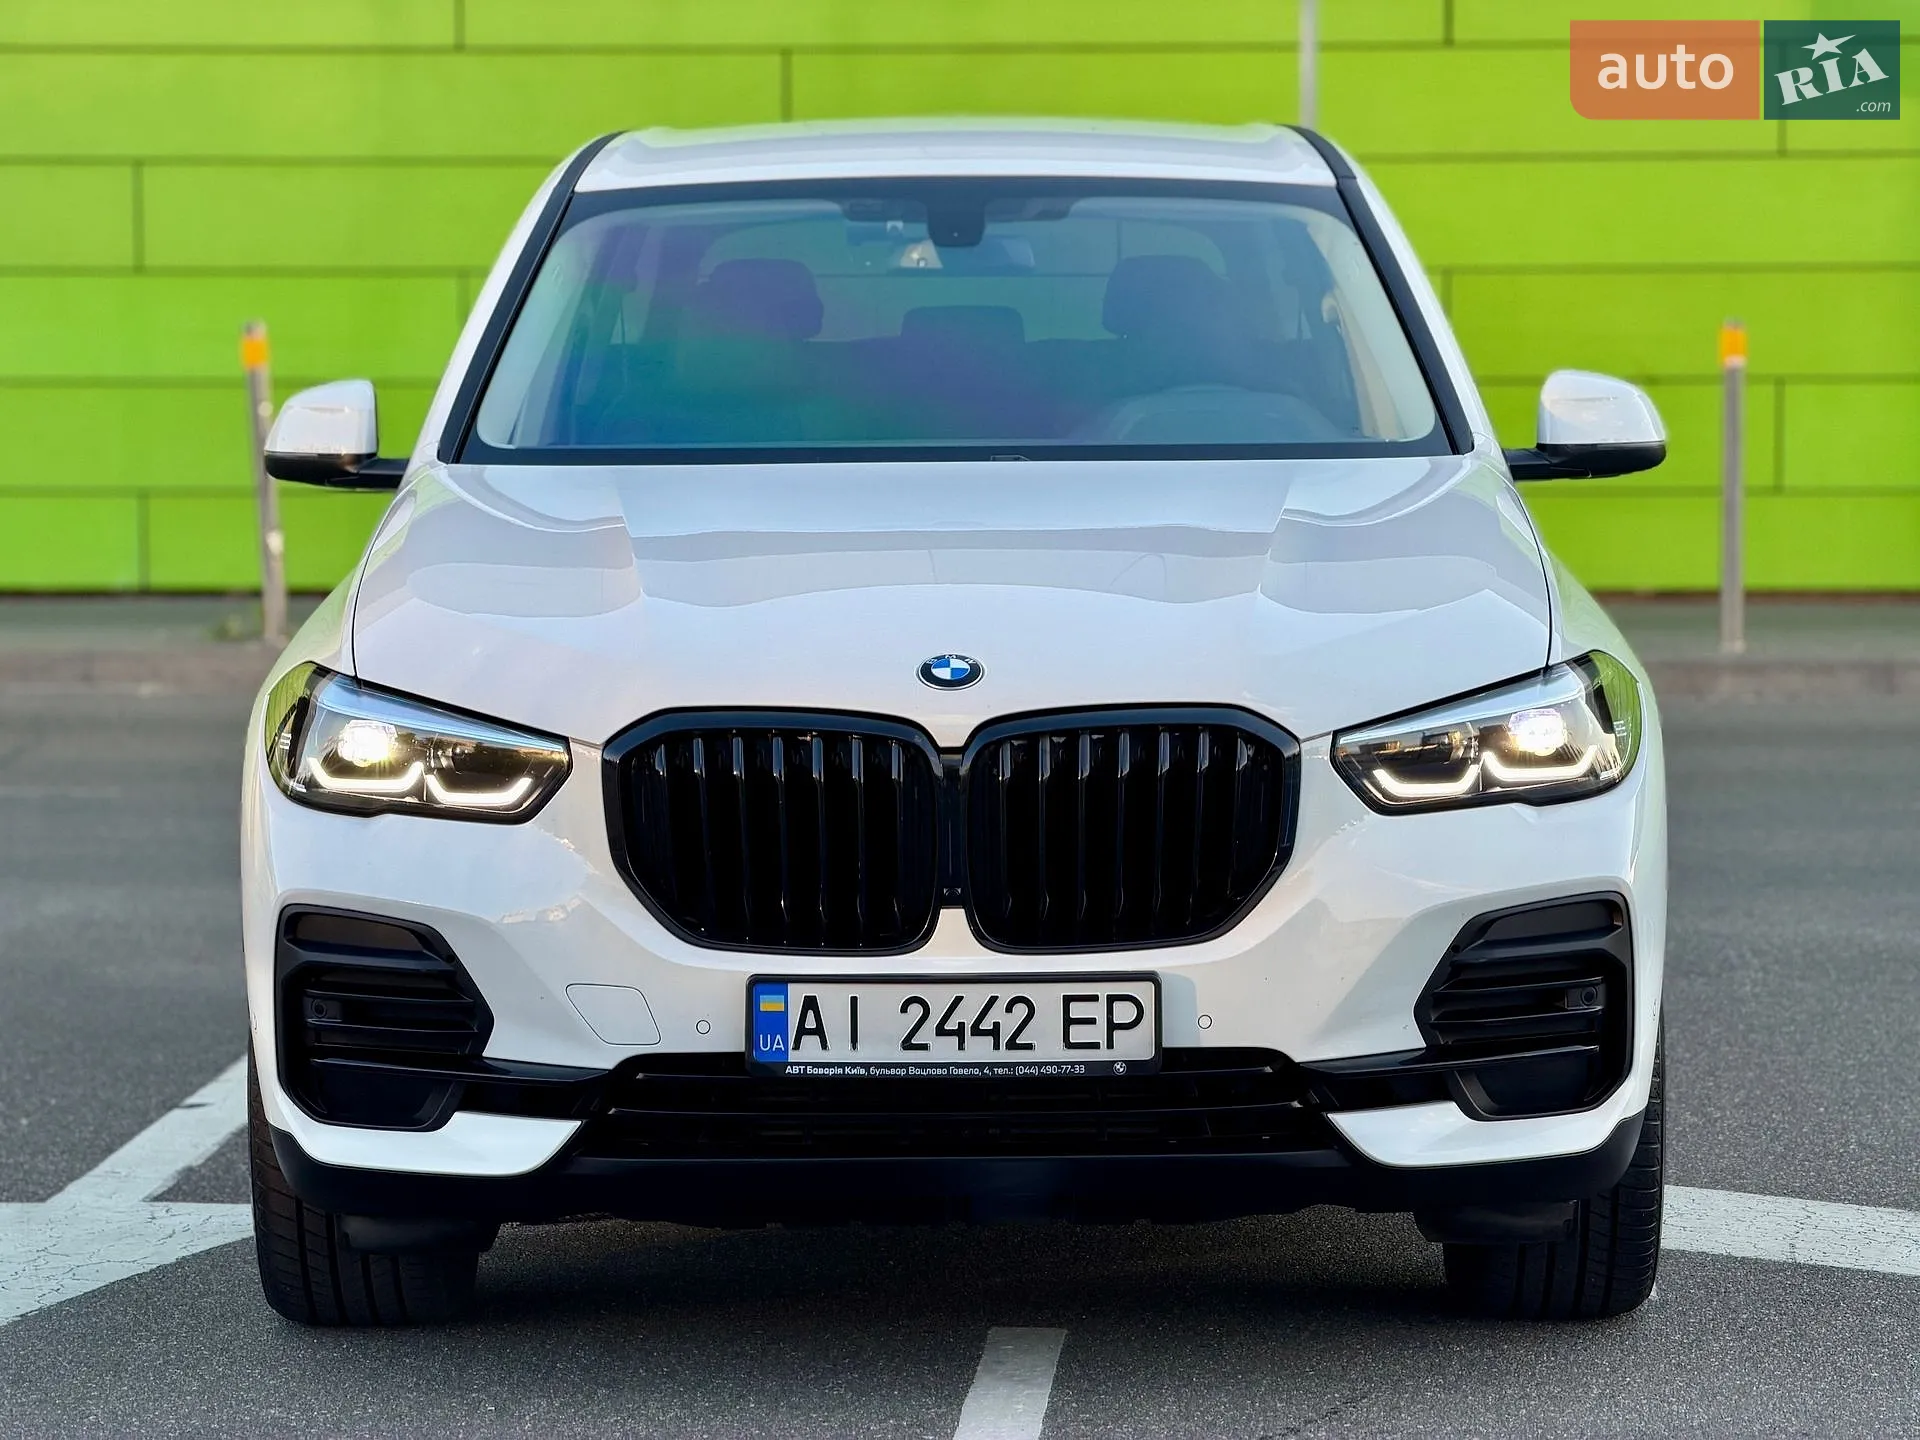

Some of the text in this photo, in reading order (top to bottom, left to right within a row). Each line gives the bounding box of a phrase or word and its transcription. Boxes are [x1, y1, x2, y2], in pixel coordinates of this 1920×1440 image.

[790, 993, 1146, 1051] AI 2442 EP
[759, 1034, 785, 1052] UA
[1015, 1064, 1039, 1076] (044)
[1040, 1064, 1085, 1075] 490-77-33
